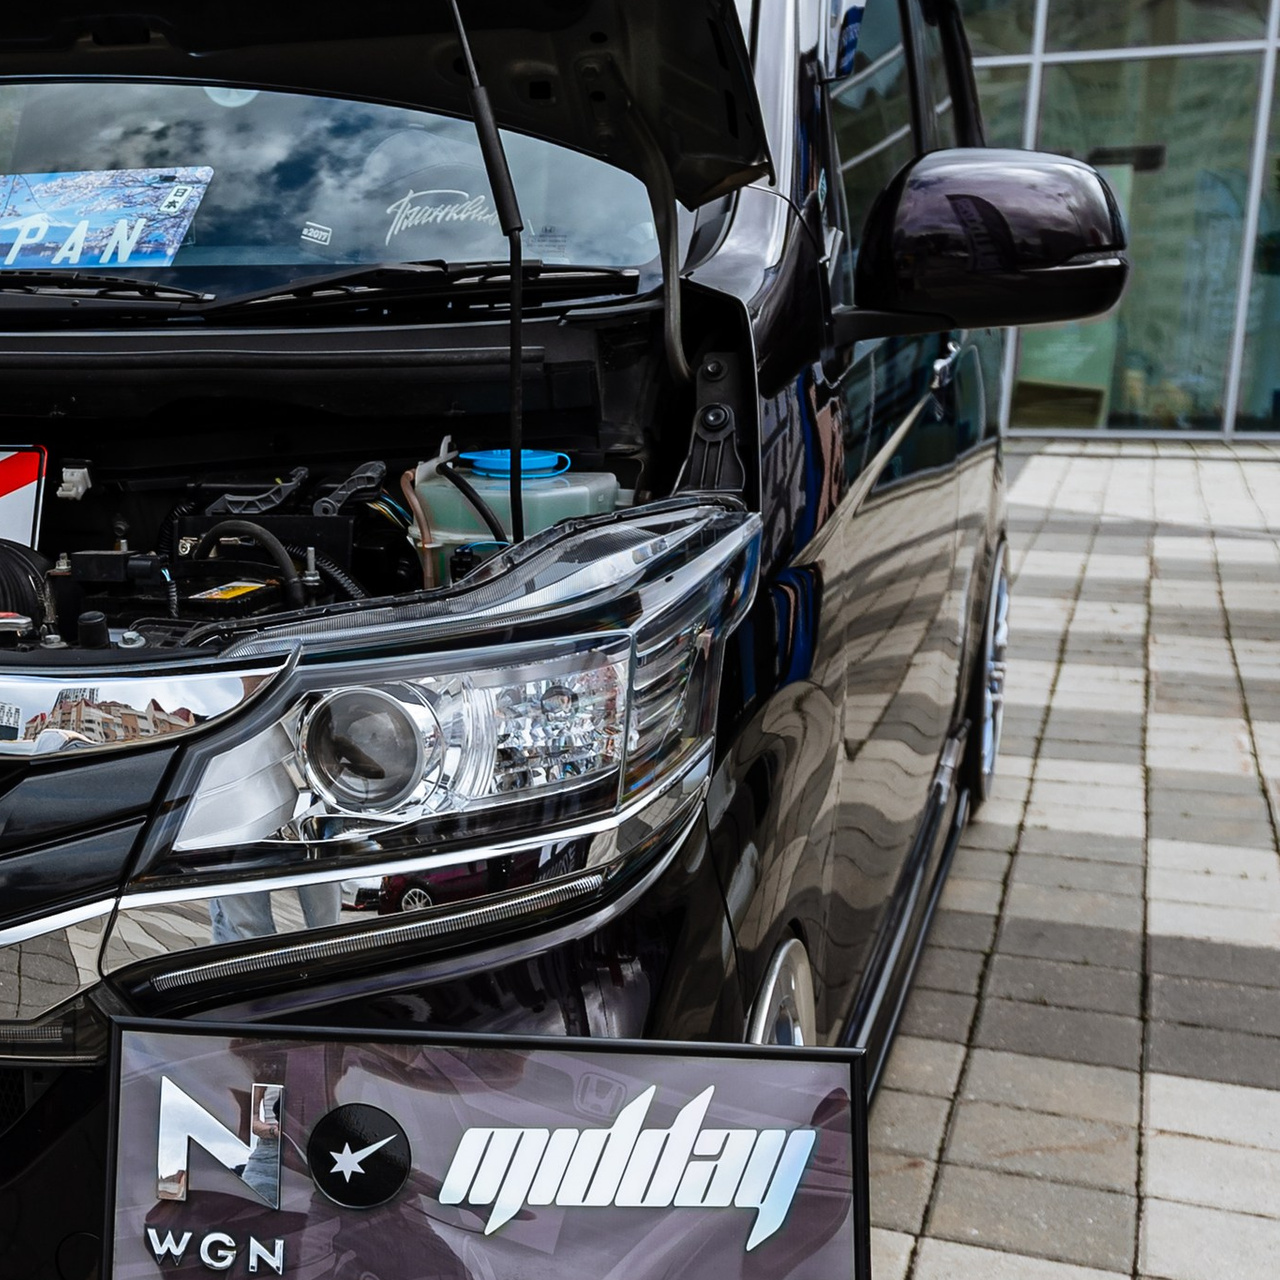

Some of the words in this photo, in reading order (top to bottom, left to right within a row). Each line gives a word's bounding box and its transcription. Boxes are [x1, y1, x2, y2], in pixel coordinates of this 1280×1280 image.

[164, 187, 188, 210] 日本
[156, 1075, 284, 1210] N
[147, 1227, 284, 1275] WGN
